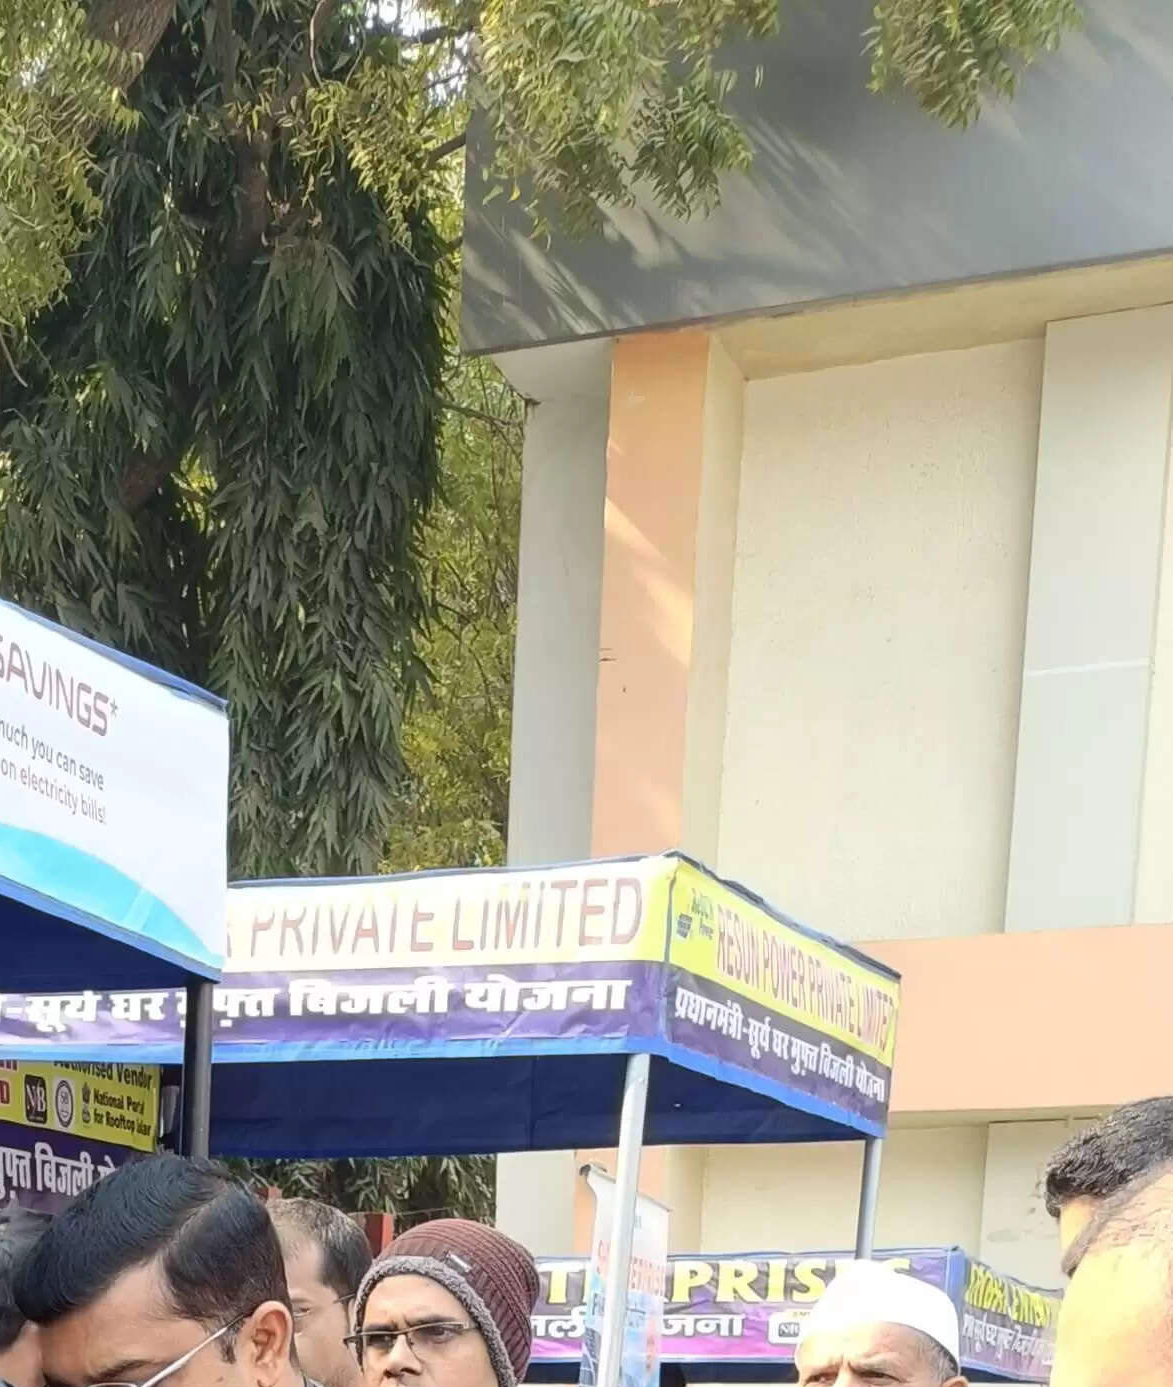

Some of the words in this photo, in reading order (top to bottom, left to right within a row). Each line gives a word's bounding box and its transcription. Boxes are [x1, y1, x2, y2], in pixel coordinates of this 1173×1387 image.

[31, 734, 53, 766] you
[56, 750, 76, 774] can
[79, 764, 104, 790] save
[0, 757, 17, 777] on
[19, 764, 79, 816] electricity
[80, 794, 106, 825] bills!
[251, 896, 435, 956] PRIVATE
[452, 877, 643, 951] LIMITED
[289, 975, 454, 1017] बिजली
[464, 973, 633, 1012] योजना
[93, 1087, 125, 1111] National
[94, 1108, 104, 1125] for
